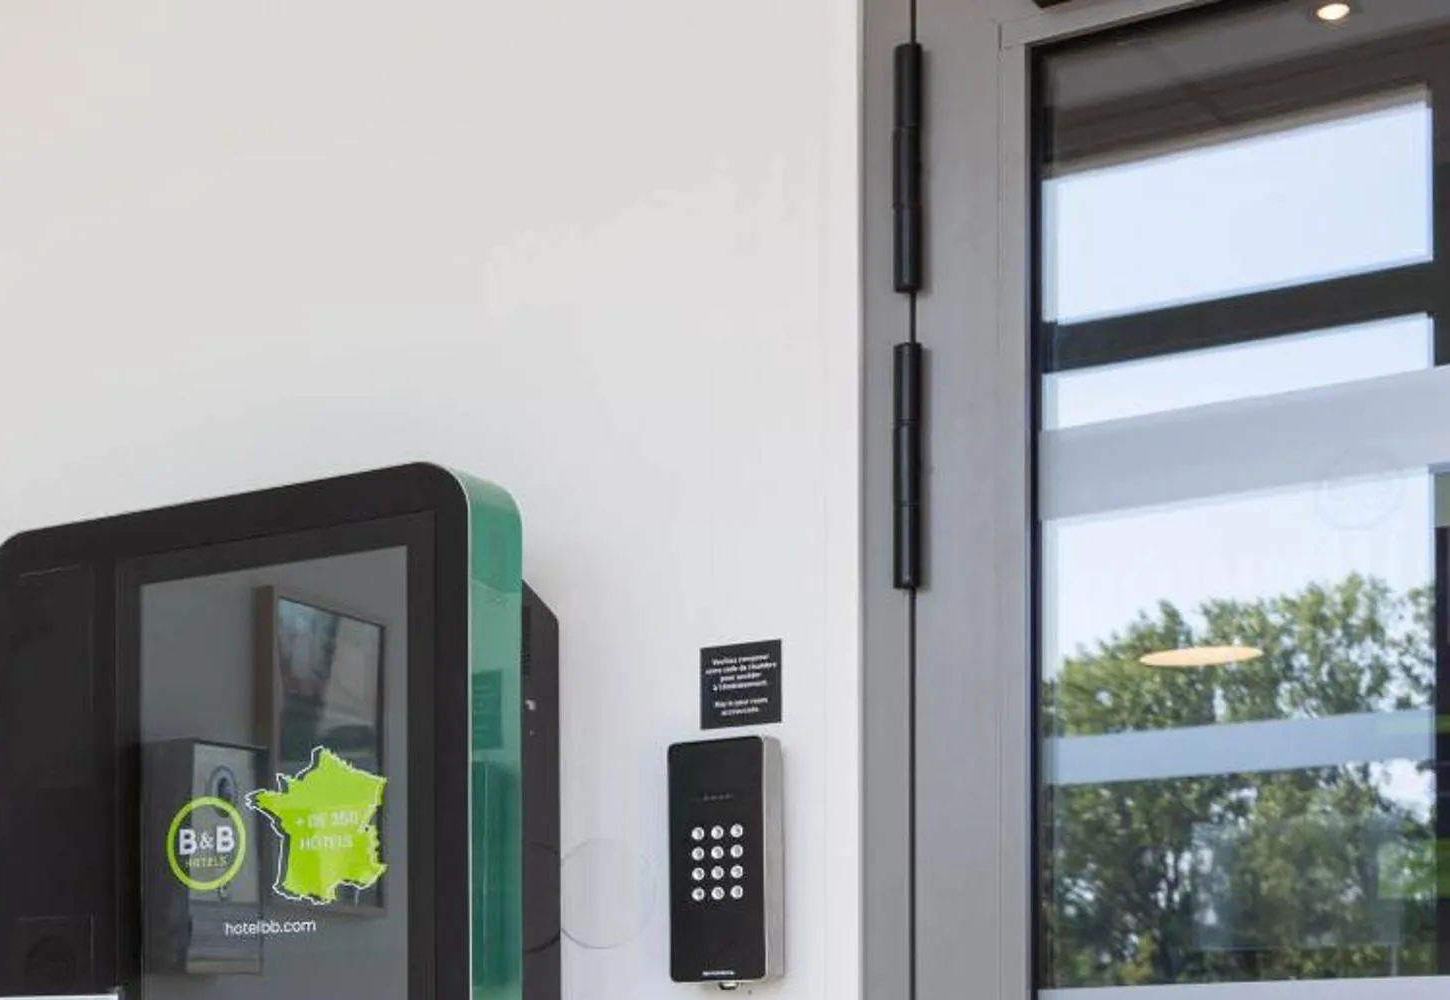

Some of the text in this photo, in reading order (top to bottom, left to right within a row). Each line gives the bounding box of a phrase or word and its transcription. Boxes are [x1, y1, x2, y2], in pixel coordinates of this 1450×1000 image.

[178, 826, 236, 856] B&B
[185, 857, 228, 868] HOTELS
[224, 919, 317, 936] hotelbb.com
